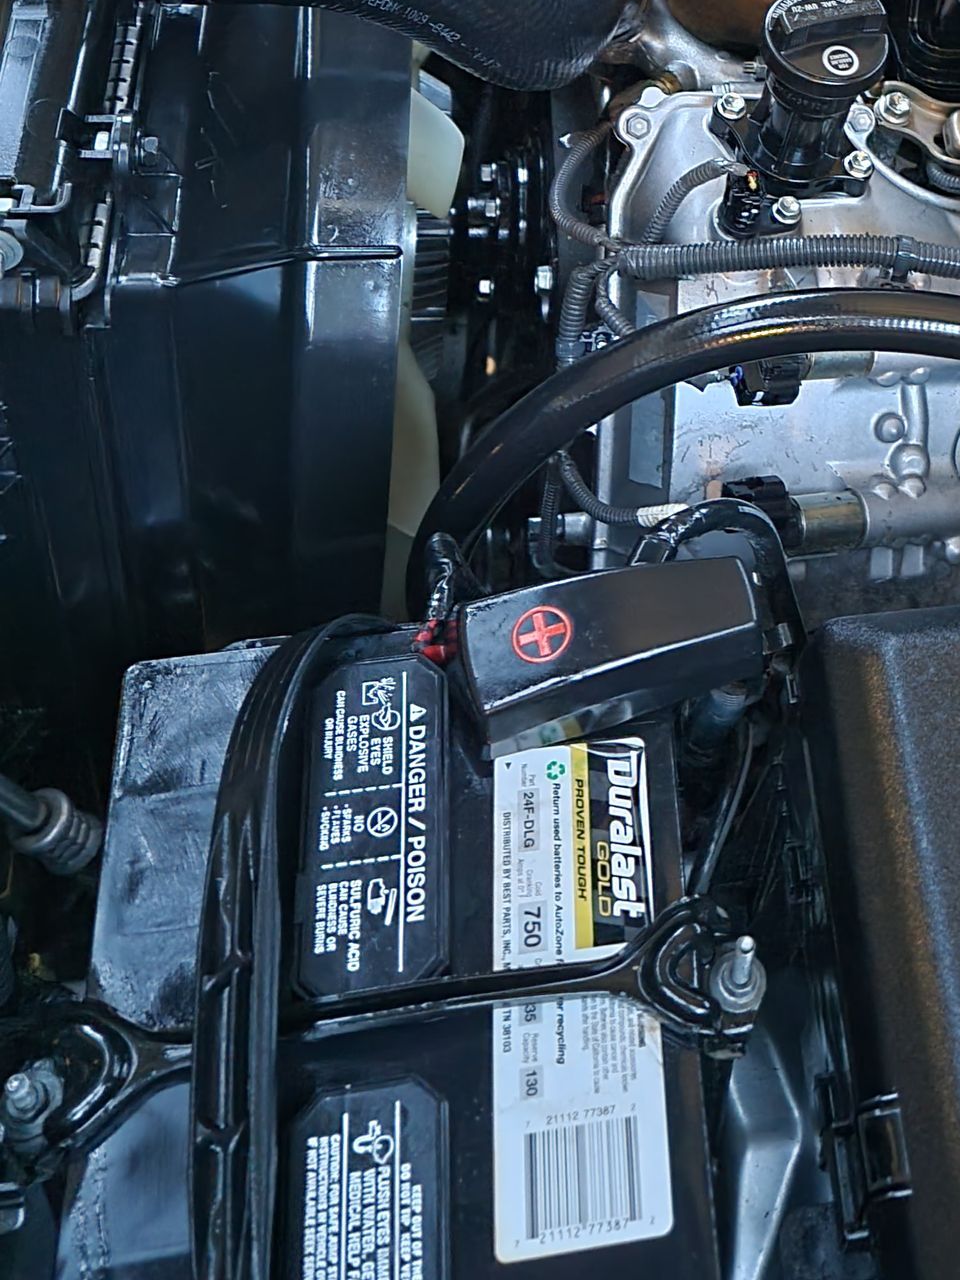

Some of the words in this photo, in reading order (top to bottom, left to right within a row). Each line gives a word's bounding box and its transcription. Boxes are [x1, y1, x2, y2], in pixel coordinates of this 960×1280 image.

[336, 690, 346, 707] CAN
[324, 718, 335, 730] OR
[335, 708, 345, 735] CAUSE
[346, 716, 358, 751] GASES
[333, 736, 344, 780] BLINDNESS
[357, 714, 370, 773] EXPLOSIVE
[370, 738, 381, 766] EYES
[382, 736, 393, 774] SHIELD
[408, 725, 426, 812] DANGER
[552, 783, 561, 815] Return
[575, 778, 586, 840] PROVEN
[341, 808, 352, 843] SPARKS
[353, 815, 365, 832] NO
[523, 792, 535, 848] 24F-DLG
[553, 818, 562, 840] used
[607, 750, 646, 917] Duralast
[502, 811, 511, 866] DISTRIBUTED
[406, 836, 425, 922] POISON
[502, 868, 511, 879] BY
[553, 844, 562, 889] batteries
[577, 845, 587, 899] TOUGH
[596, 841, 611, 916] GOLD
[316, 884, 327, 919] SEVERE
[339, 881, 349, 900] CAN
[503, 882, 511, 904] BEST
[554, 891, 562, 901] to
[327, 883, 338, 933] BLINDNESS
[337, 904, 348, 935] CAUSE
[349, 879, 362, 940] SULFURIC
[501, 907, 511, 937] PARTS,
[314, 921, 326, 954] BURNS
[524, 906, 541, 947] 750
[554, 904, 563, 955] AutoZone
[326, 936, 337, 951] OR
[347, 942, 360, 971] ACID
[502, 1010, 512, 1022] TN
[524, 1003, 536, 1022] 35
[503, 1024, 512, 1053] 38103
[556, 1013, 566, 1064] recycling
[526, 1070, 538, 1096] 130
[306, 1149, 317, 1170] NOT
[318, 1136, 329, 1210] INSTRUCTIONS
[401, 1163, 411, 1180] DO
[305, 1171, 317, 1227] AVAILABLE
[329, 1183, 340, 1205] FOR
[348, 1171, 361, 1232] MEDICAL
[363, 1167, 376, 1204] WITH
[378, 1165, 391, 1210] FLUSH
[401, 1182, 411, 1205] NOT
[412, 1184, 422, 1213] KEEP
[328, 1206, 339, 1233] SAFE
[362, 1205, 376, 1259] WATER.
[377, 1210, 390, 1245] EYES
[412, 1215, 422, 1238] OUT
[316, 1223, 327, 1268] VEHICLE
[328, 1234, 339, 1264] JUMP
[347, 1231, 361, 1267] HELP
[400, 1232, 411, 1261] KEEP
[411, 1240, 422, 1256] OF
